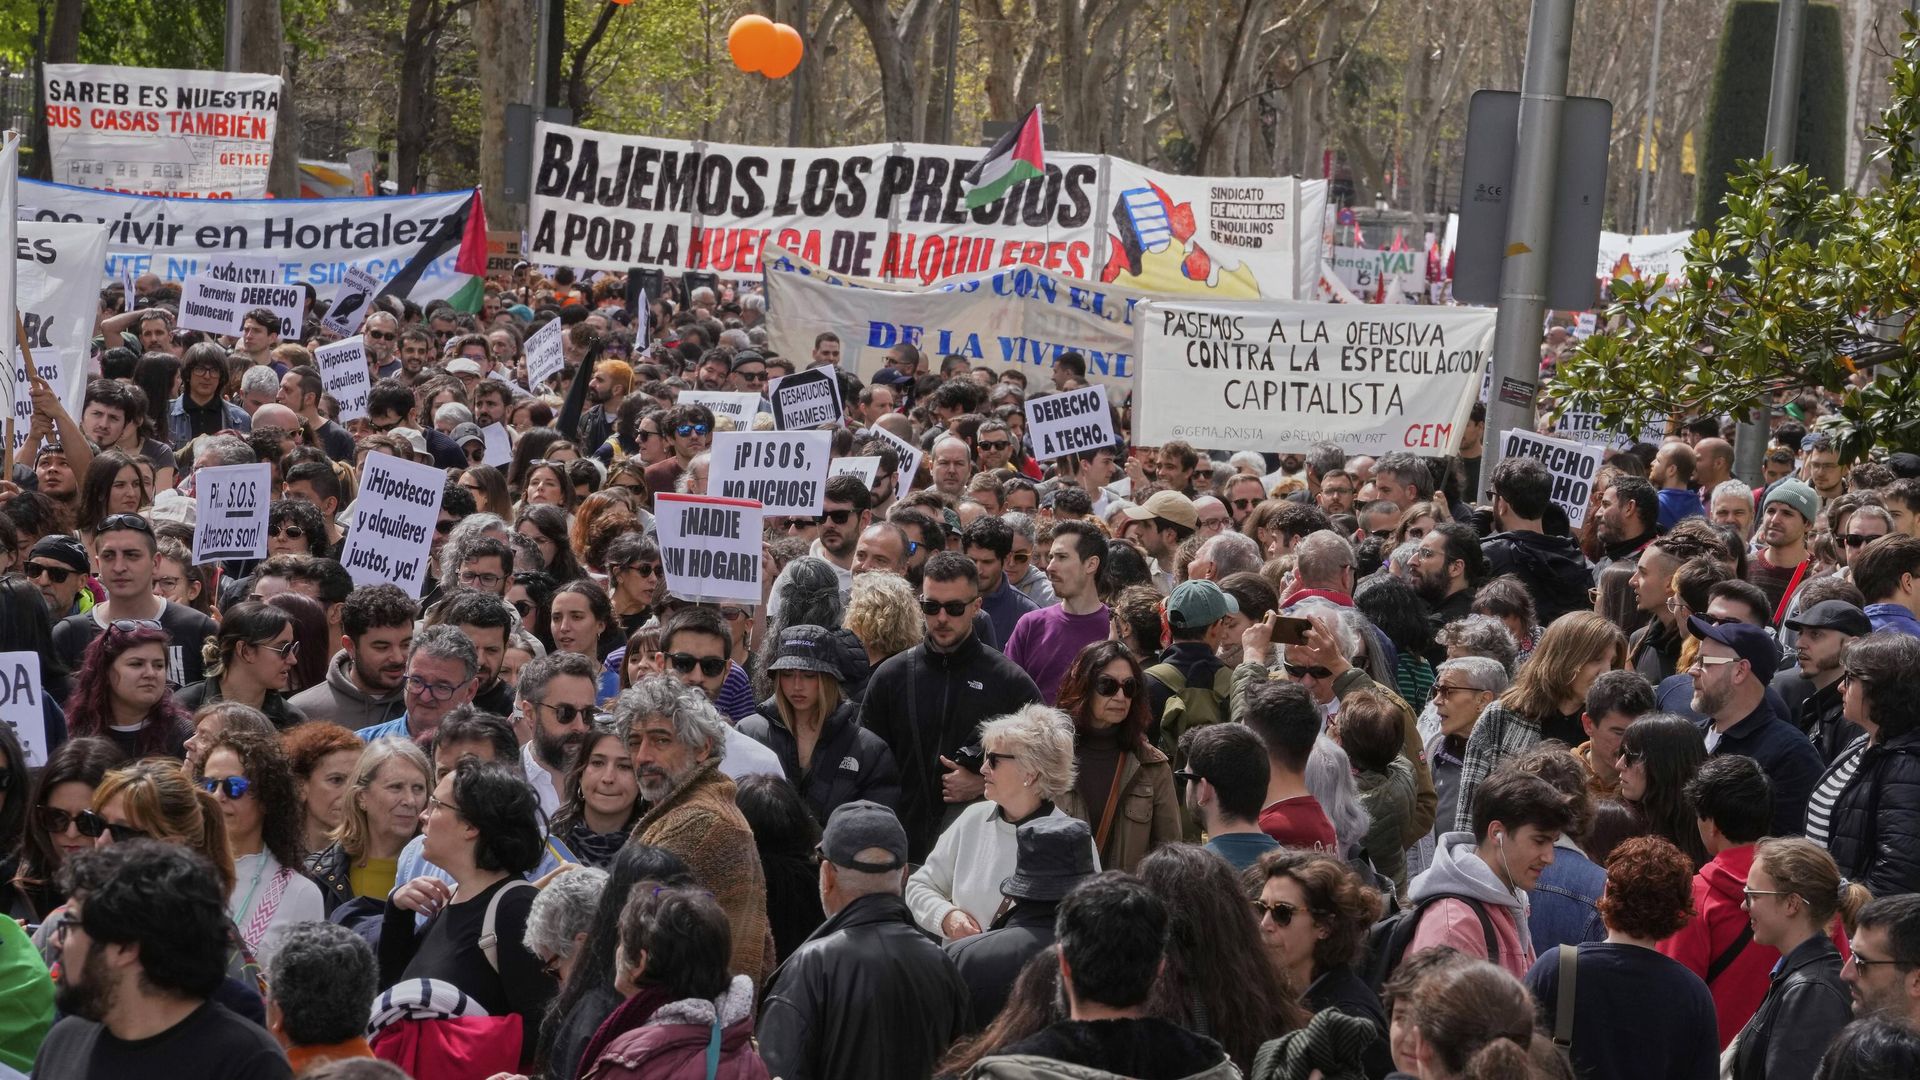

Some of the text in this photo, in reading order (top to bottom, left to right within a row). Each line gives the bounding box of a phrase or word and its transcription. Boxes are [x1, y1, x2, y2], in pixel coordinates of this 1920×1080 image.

[50, 80, 278, 111] SAREB ES NUESTRA
[46, 105, 266, 139] SUS CASAS TAMBIÉN
[219, 153, 269, 166] GETAFE
[536, 132, 768, 218] BAJEMOS
[773, 156, 872, 218] LOS
[1210, 187, 1263, 200] SINDICATO
[1212, 203, 1284, 219] DE INQUILINAS
[97, 213, 183, 246] vivir
[195, 224, 248, 249] en
[532, 209, 557, 253] A
[561, 213, 635, 262] POR
[638, 222, 679, 267] LA
[828, 230, 876, 277] DE
[1210, 220, 1274, 235] E INQUILINOS
[1210, 230, 1263, 248] DE MADRID
[366, 257, 460, 284] CAAS
[1335, 257, 1372, 270] enda
[240, 287, 298, 308] DERECHO
[991, 267, 1058, 305] CON
[1069, 285, 1113, 320] EL
[17, 312, 54, 349] BC
[867, 321, 924, 350] DE
[937, 329, 983, 360] LA
[1163, 311, 1245, 341] PASEMOS
[1268, 318, 1286, 343] A
[1301, 320, 1330, 344] LA
[1346, 321, 1445, 347] OFENSIVA
[1186, 340, 1275, 371] CONTRA
[1290, 344, 1320, 371] LA
[330, 371, 364, 391] alquileres
[781, 382, 830, 406] DESAHUCIOS
[1032, 391, 1101, 424] DERECHO
[1224, 379, 1404, 416] CAPITALISTA
[785, 404, 836, 429] INFAMES!!!
[1559, 415, 1612, 432] A TEC
[1044, 423, 1108, 454] A TECHO.
[1171, 425, 1264, 441] @GEMA_RXISTA
[1404, 423, 1453, 449] GEM
[1593, 432, 1628, 444] PREIO!
[734, 441, 811, 471] ¡PISOS,
[227, 481, 257, 508] S.O.S.
[366, 467, 436, 507] ¡Hipotecas
[722, 480, 817, 507] NO NICHOS!
[356, 508, 427, 544] y alquileres
[680, 507, 741, 539] ¡NADIE
[197, 521, 261, 557] ¡Atracos son!
[346, 541, 419, 582] justos, ya!
[662, 546, 758, 583] SIN HOGAR!
